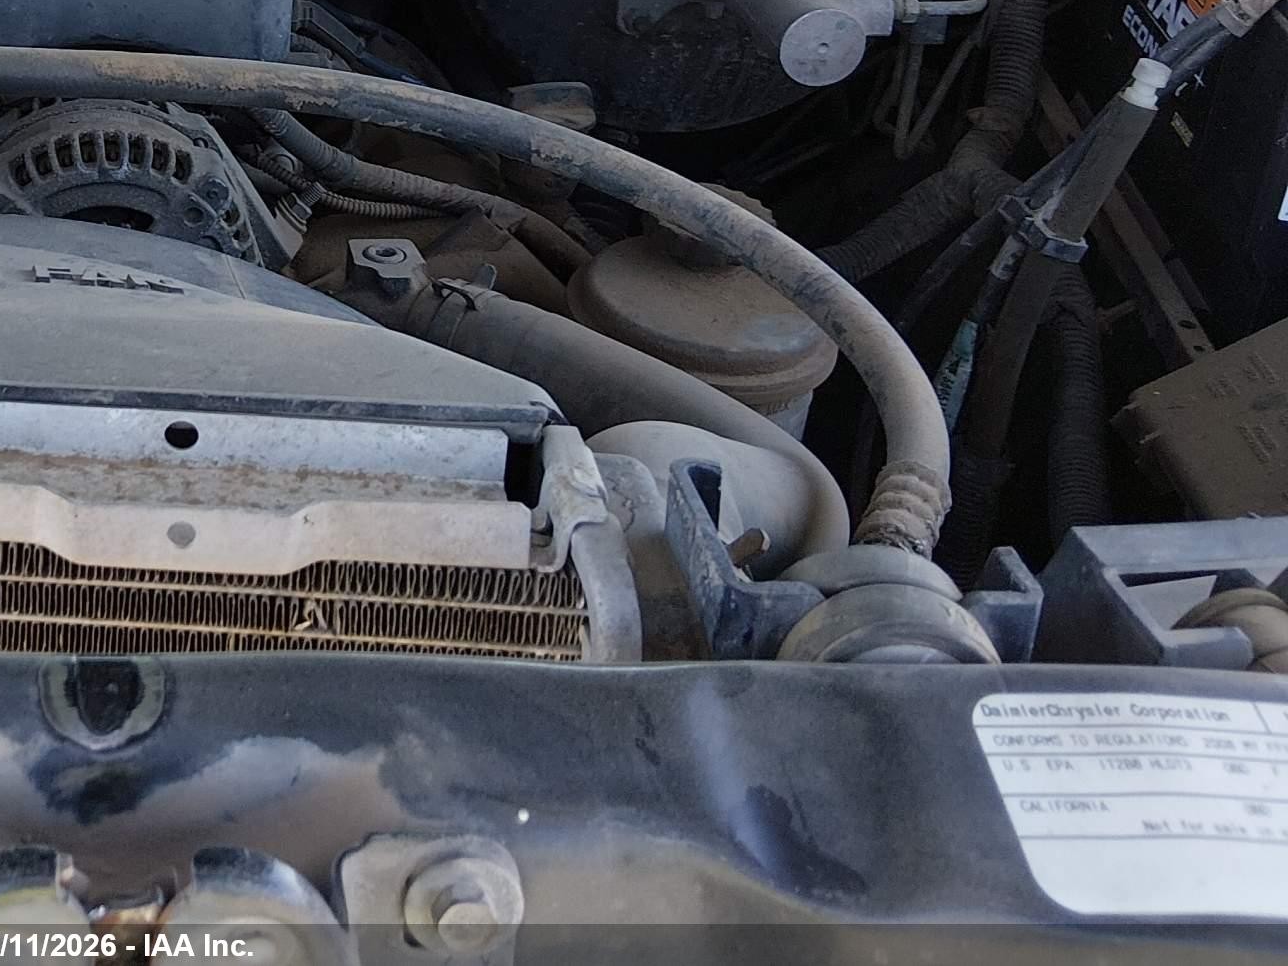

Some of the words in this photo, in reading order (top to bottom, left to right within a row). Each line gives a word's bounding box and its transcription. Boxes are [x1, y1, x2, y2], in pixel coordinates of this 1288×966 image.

[1122, 4, 1160, 58] ECON
[31, 264, 185, 295] FAN
[980, 703, 1120, 722] DaimlerChrysler
[1129, 704, 1231, 721] Corporation
[992, 734, 1063, 747] CONFORMS
[1069, 735, 1089, 747] TO
